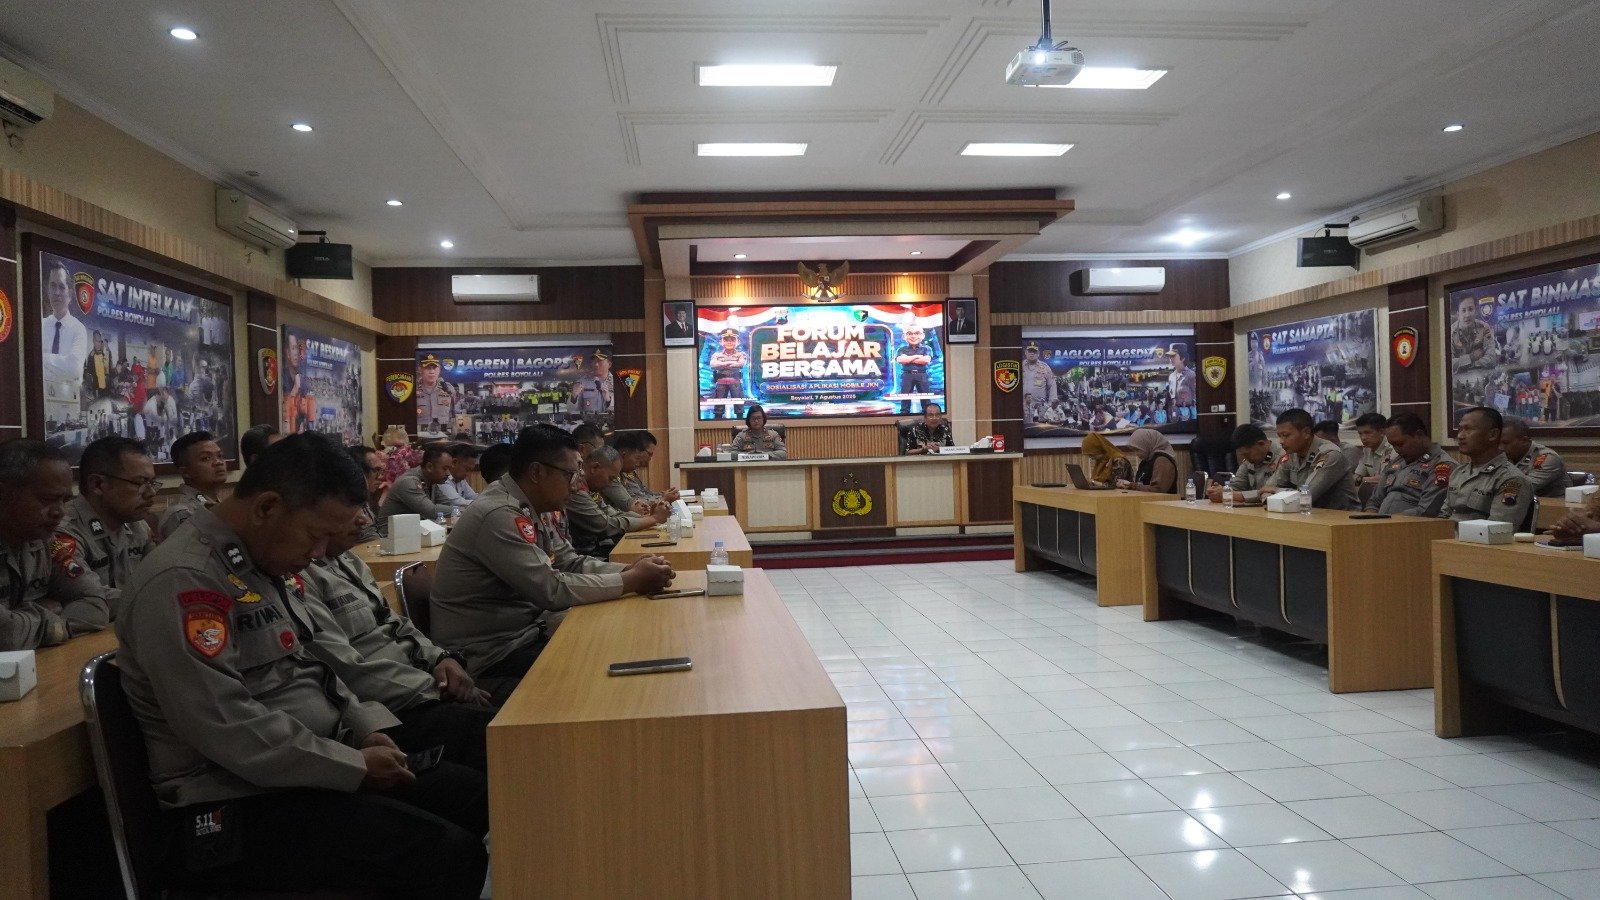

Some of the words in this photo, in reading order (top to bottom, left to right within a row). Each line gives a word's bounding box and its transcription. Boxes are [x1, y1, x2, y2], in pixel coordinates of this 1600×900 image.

[98, 278, 125, 306] SAT
[128, 286, 193, 321] INTELKAM
[1497, 289, 1527, 310] SAT
[98, 305, 123, 321] POLRES
[125, 312, 155, 327] BOYOLALI
[1498, 312, 1523, 321] POLRES
[777, 322, 865, 342] FORUM
[1272, 330, 1288, 345] SAT
[1289, 323, 1335, 344] SAMAPTA
[306, 339, 319, 357] SAT
[761, 340, 881, 361] BELAJAR
[1054, 349, 1101, 360] BAGLOG
[1107, 348, 1155, 360] BAGSDM
[457, 358, 510, 371] BAGREN
[516, 357, 571, 369] BAGOPS
[761, 359, 881, 378] BERSAMA
[196, 812, 216, 829] 5.11
